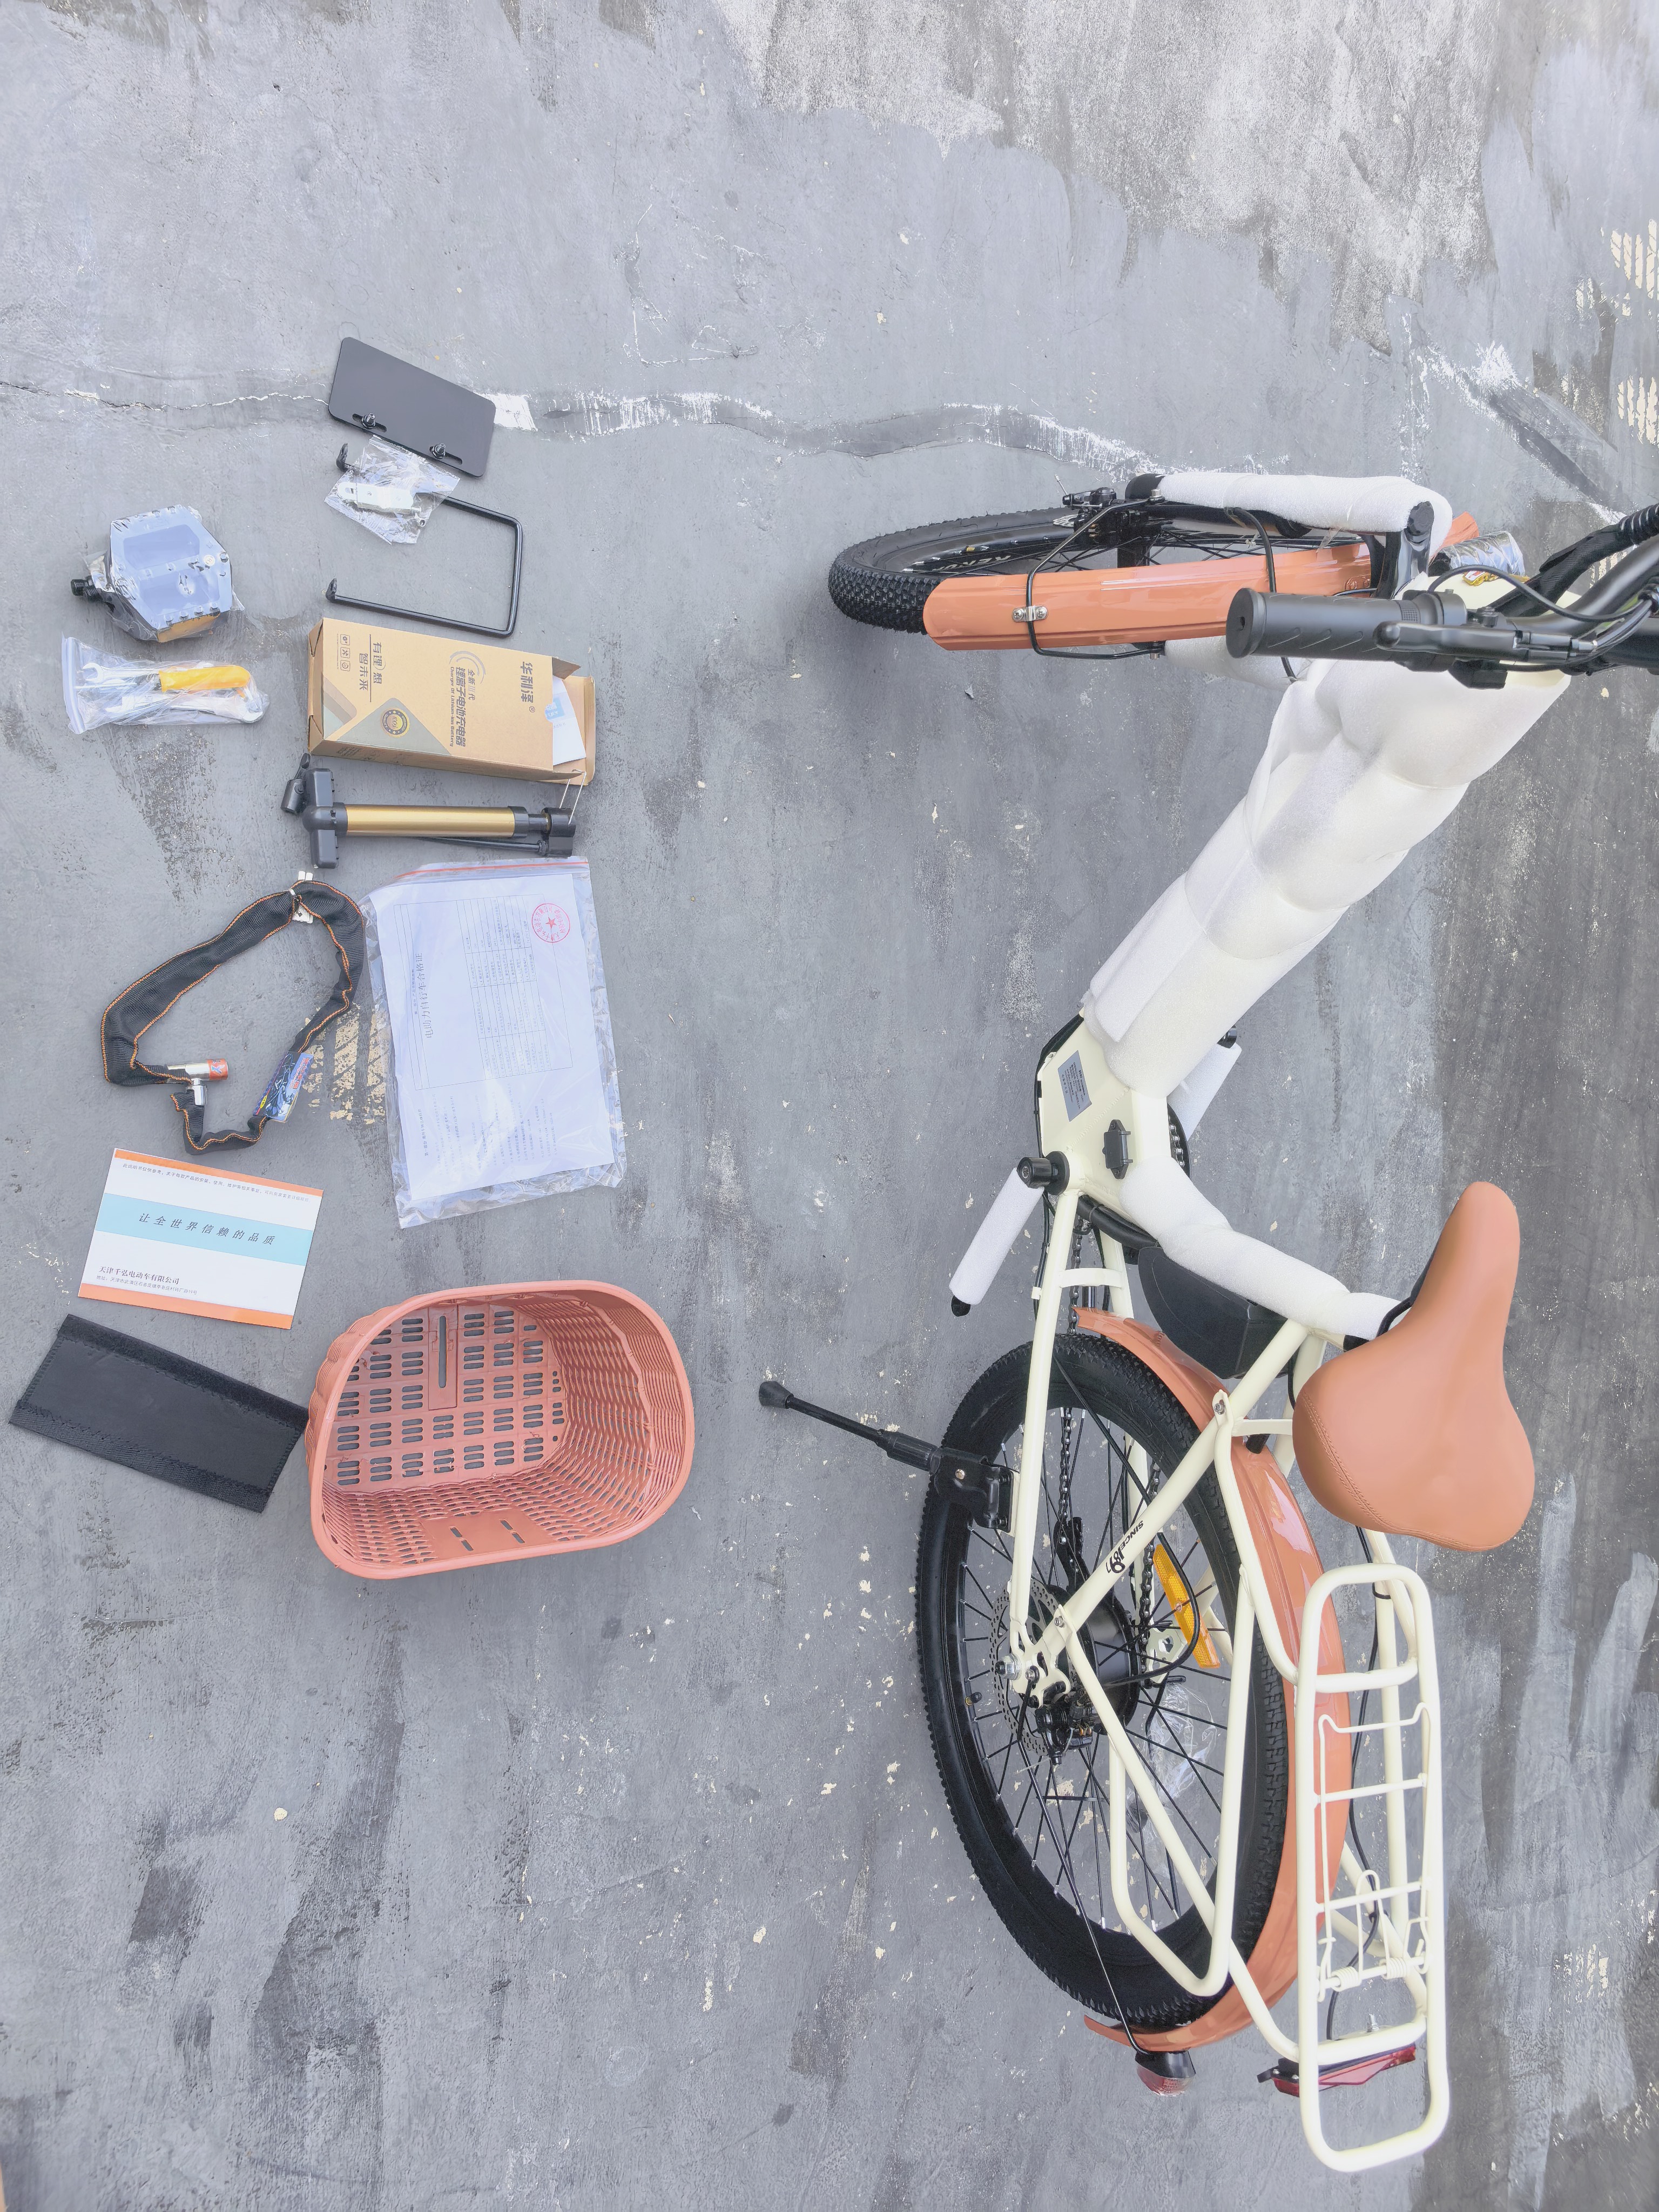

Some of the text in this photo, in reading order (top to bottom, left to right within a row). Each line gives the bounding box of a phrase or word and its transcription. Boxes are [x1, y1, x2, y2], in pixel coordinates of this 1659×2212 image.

[456, 667, 466, 747] 锂离子电池充电器
[415, 953, 434, 1038] 电助力自行车合格证
[139, 1213, 275, 1245] 让全世界信赖的品质
[99, 1266, 179, 1285] 天津千弘电动车有限公司
